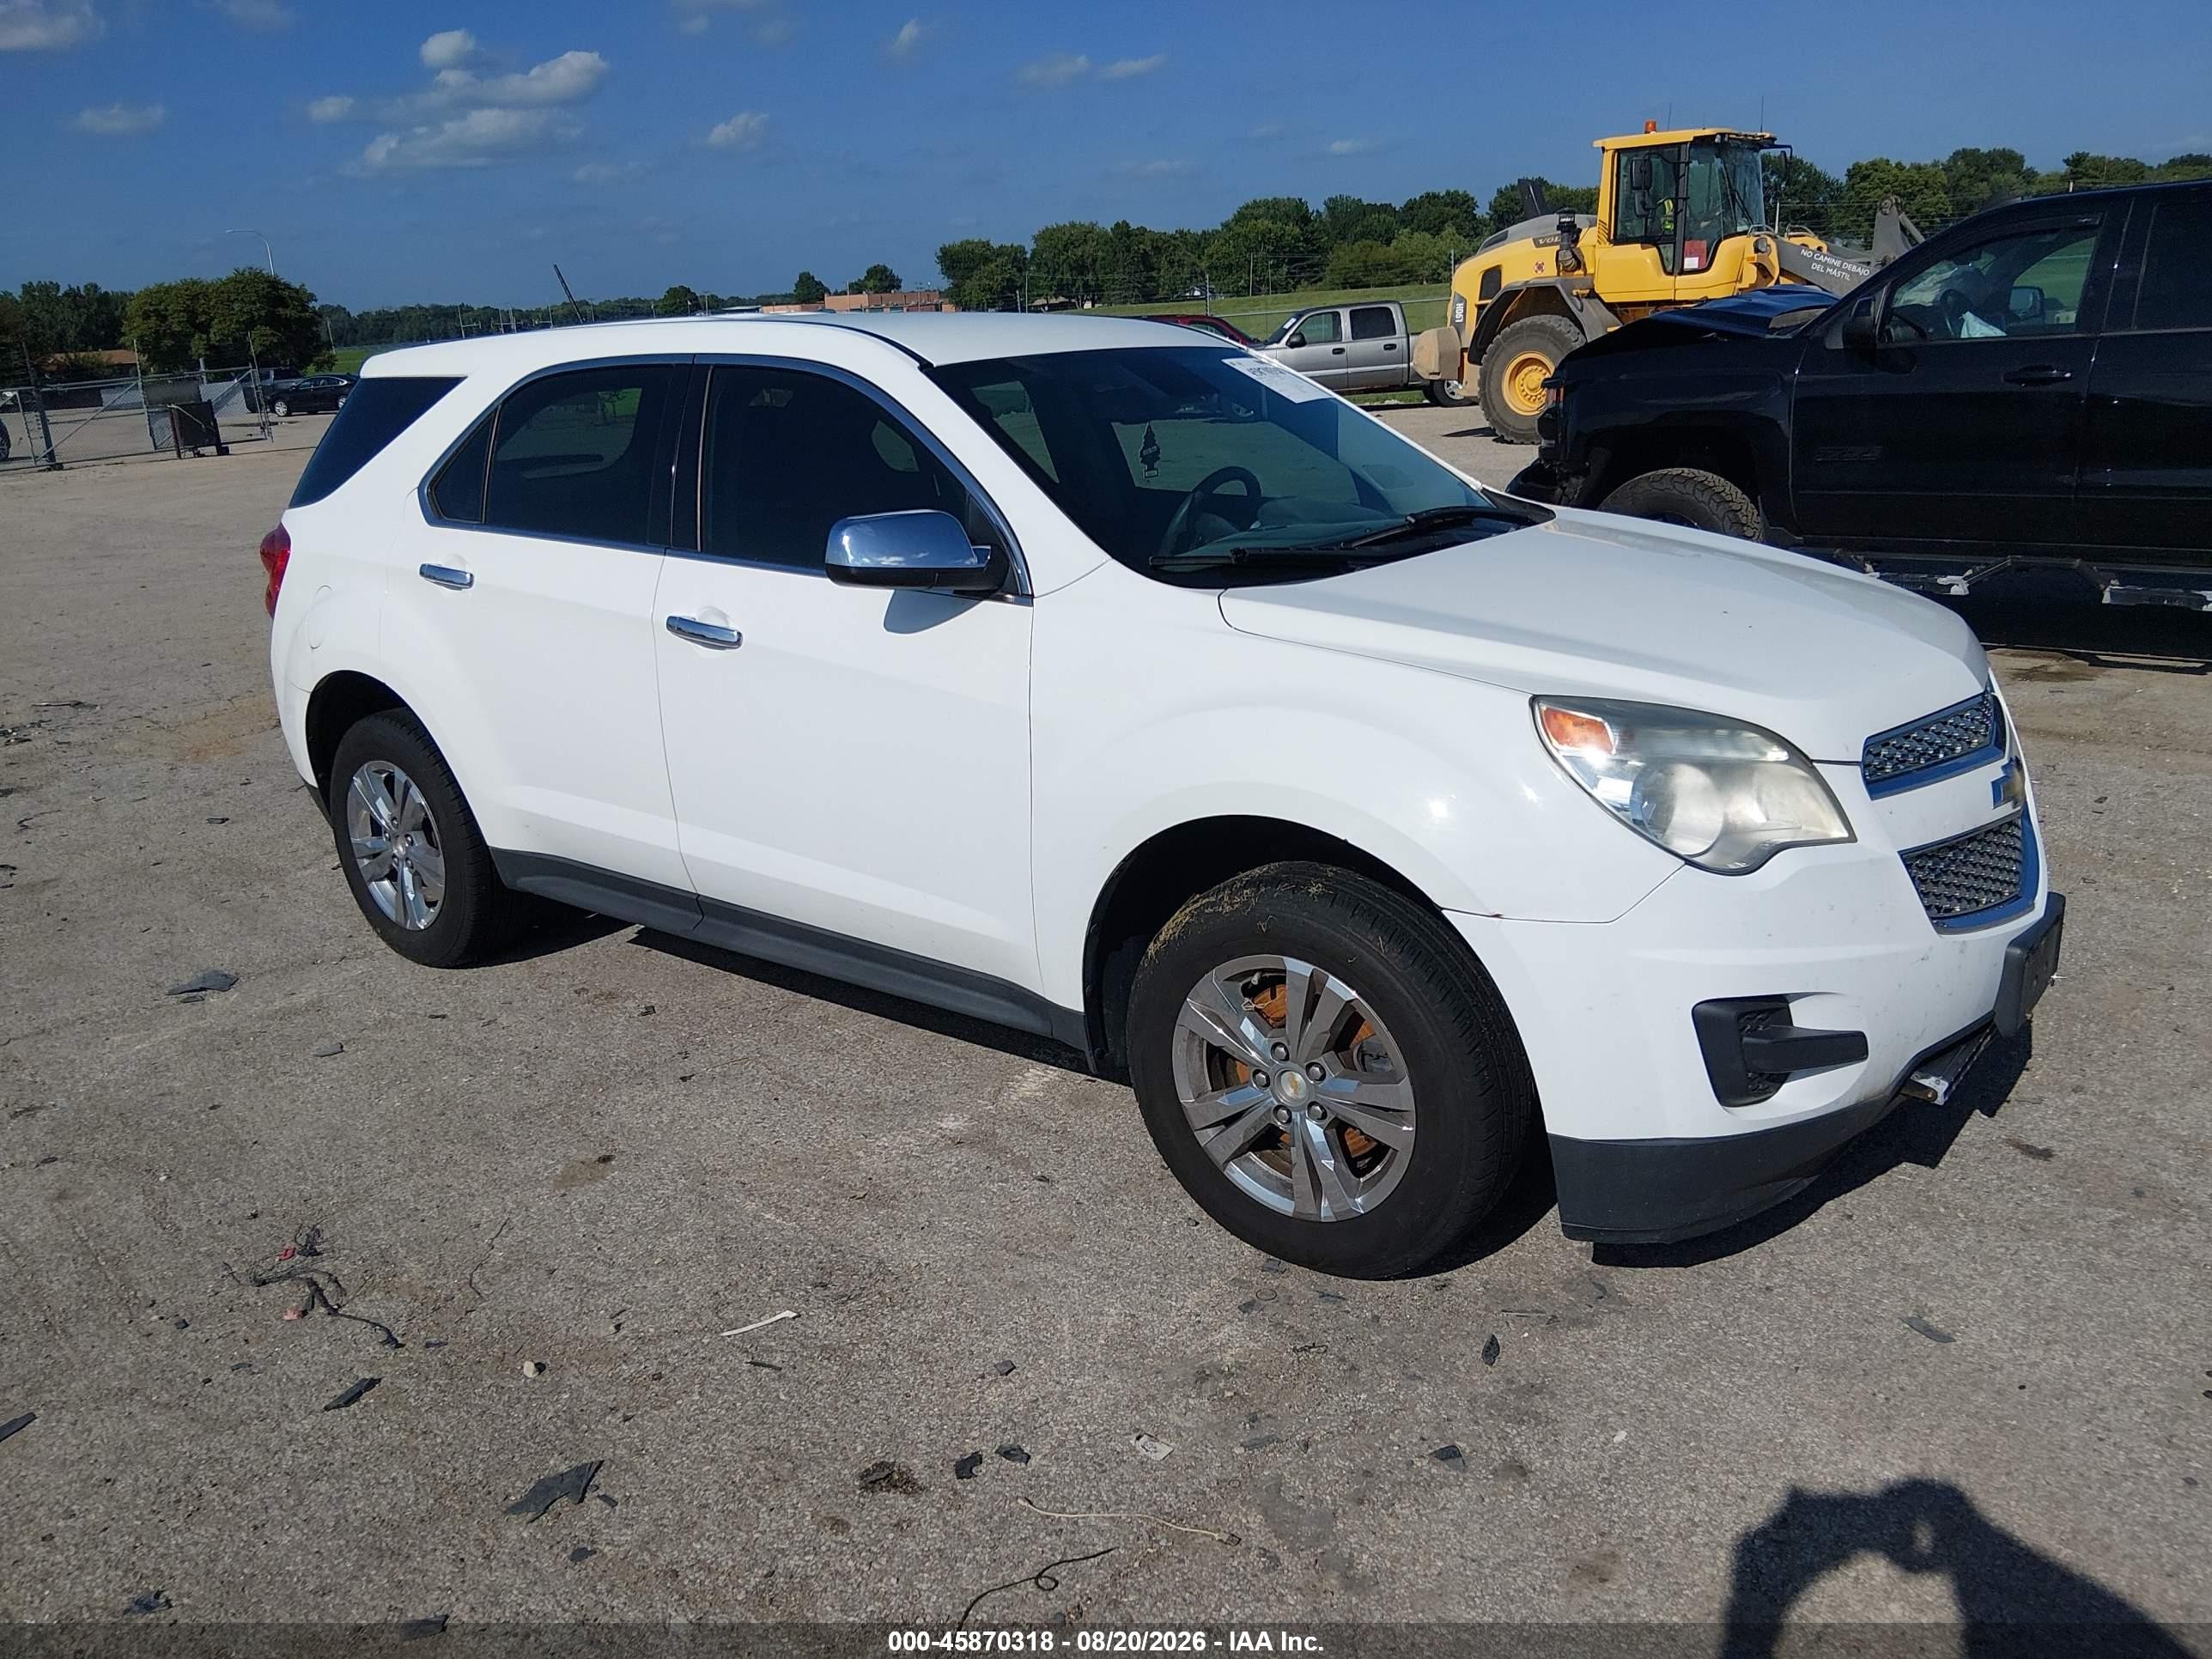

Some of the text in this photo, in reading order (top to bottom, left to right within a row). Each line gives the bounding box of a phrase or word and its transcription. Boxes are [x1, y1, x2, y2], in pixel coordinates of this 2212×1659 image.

[1539, 235, 1561, 245] VOL
[1800, 248, 1870, 276] NO CAMINE DEBAJO
[1811, 263, 1851, 281] DEL MÁSTIL
[1455, 303, 1464, 323] L90H
